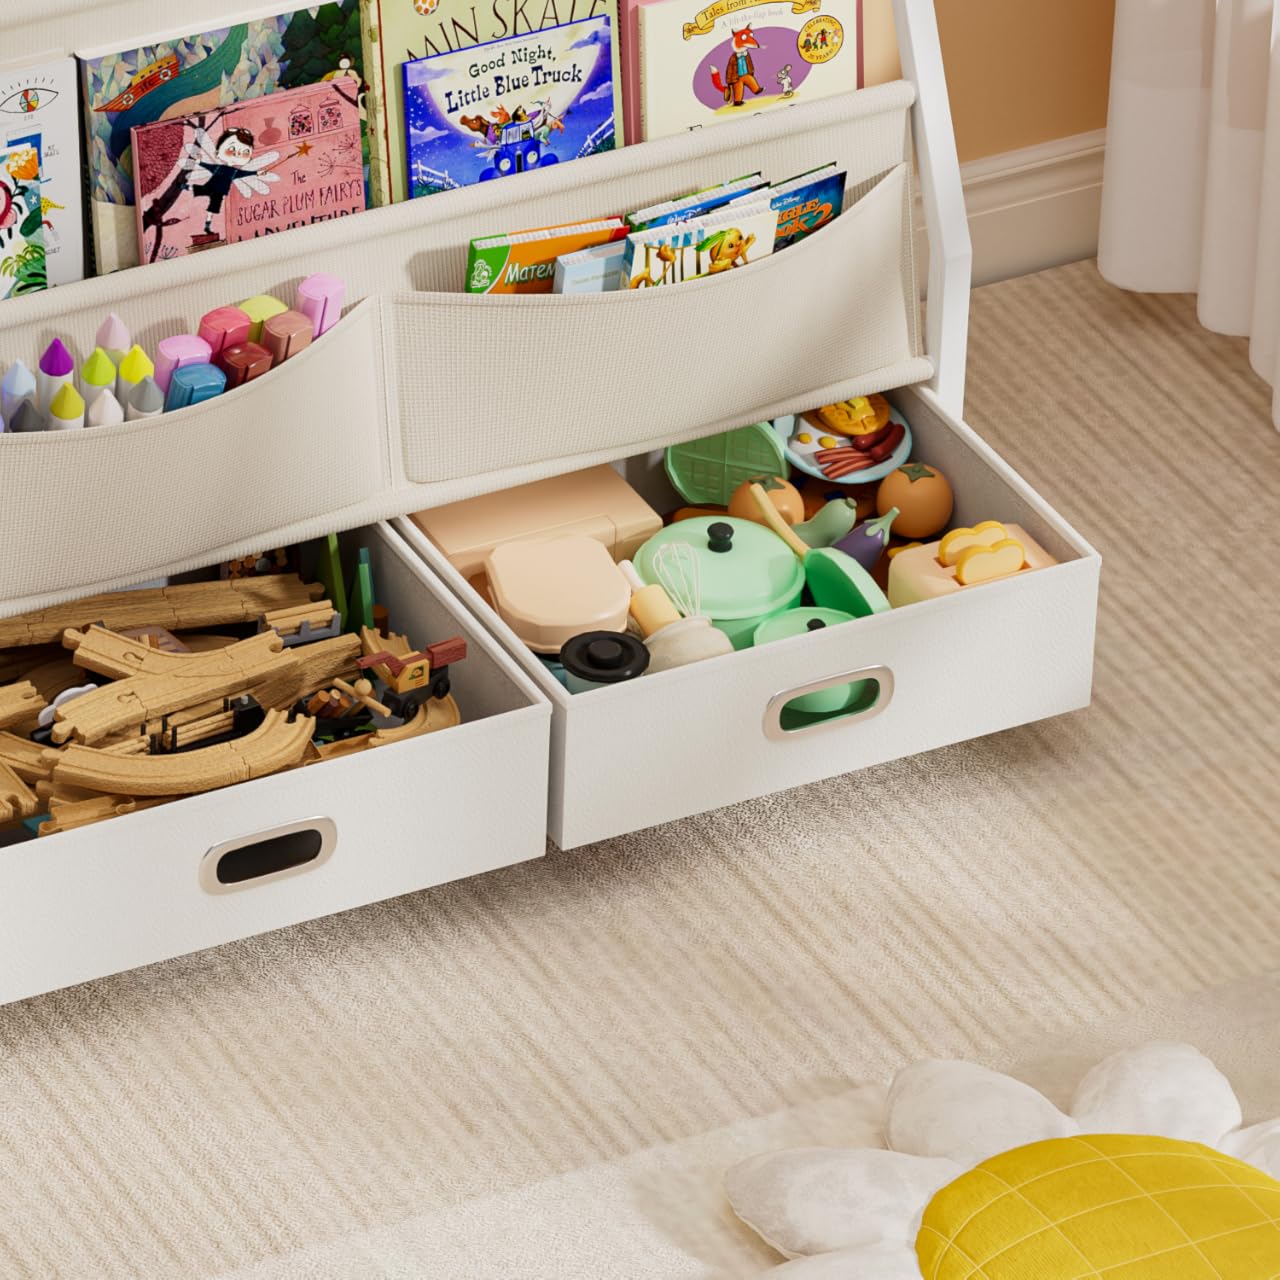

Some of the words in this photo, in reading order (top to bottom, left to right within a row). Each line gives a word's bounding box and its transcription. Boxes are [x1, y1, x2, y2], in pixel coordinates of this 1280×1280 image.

[701, 6, 724, 21] Tales
[468, 52, 505, 79] Good
[511, 44, 557, 65] Night,
[444, 85, 490, 115] Little
[493, 73, 530, 97] Blue
[530, 63, 583, 87] Truck
[291, 169, 307, 186] The
[237, 199, 280, 226] SUGAR
[282, 189, 315, 215] PLUM
[319, 178, 362, 206] FAIRY'S
